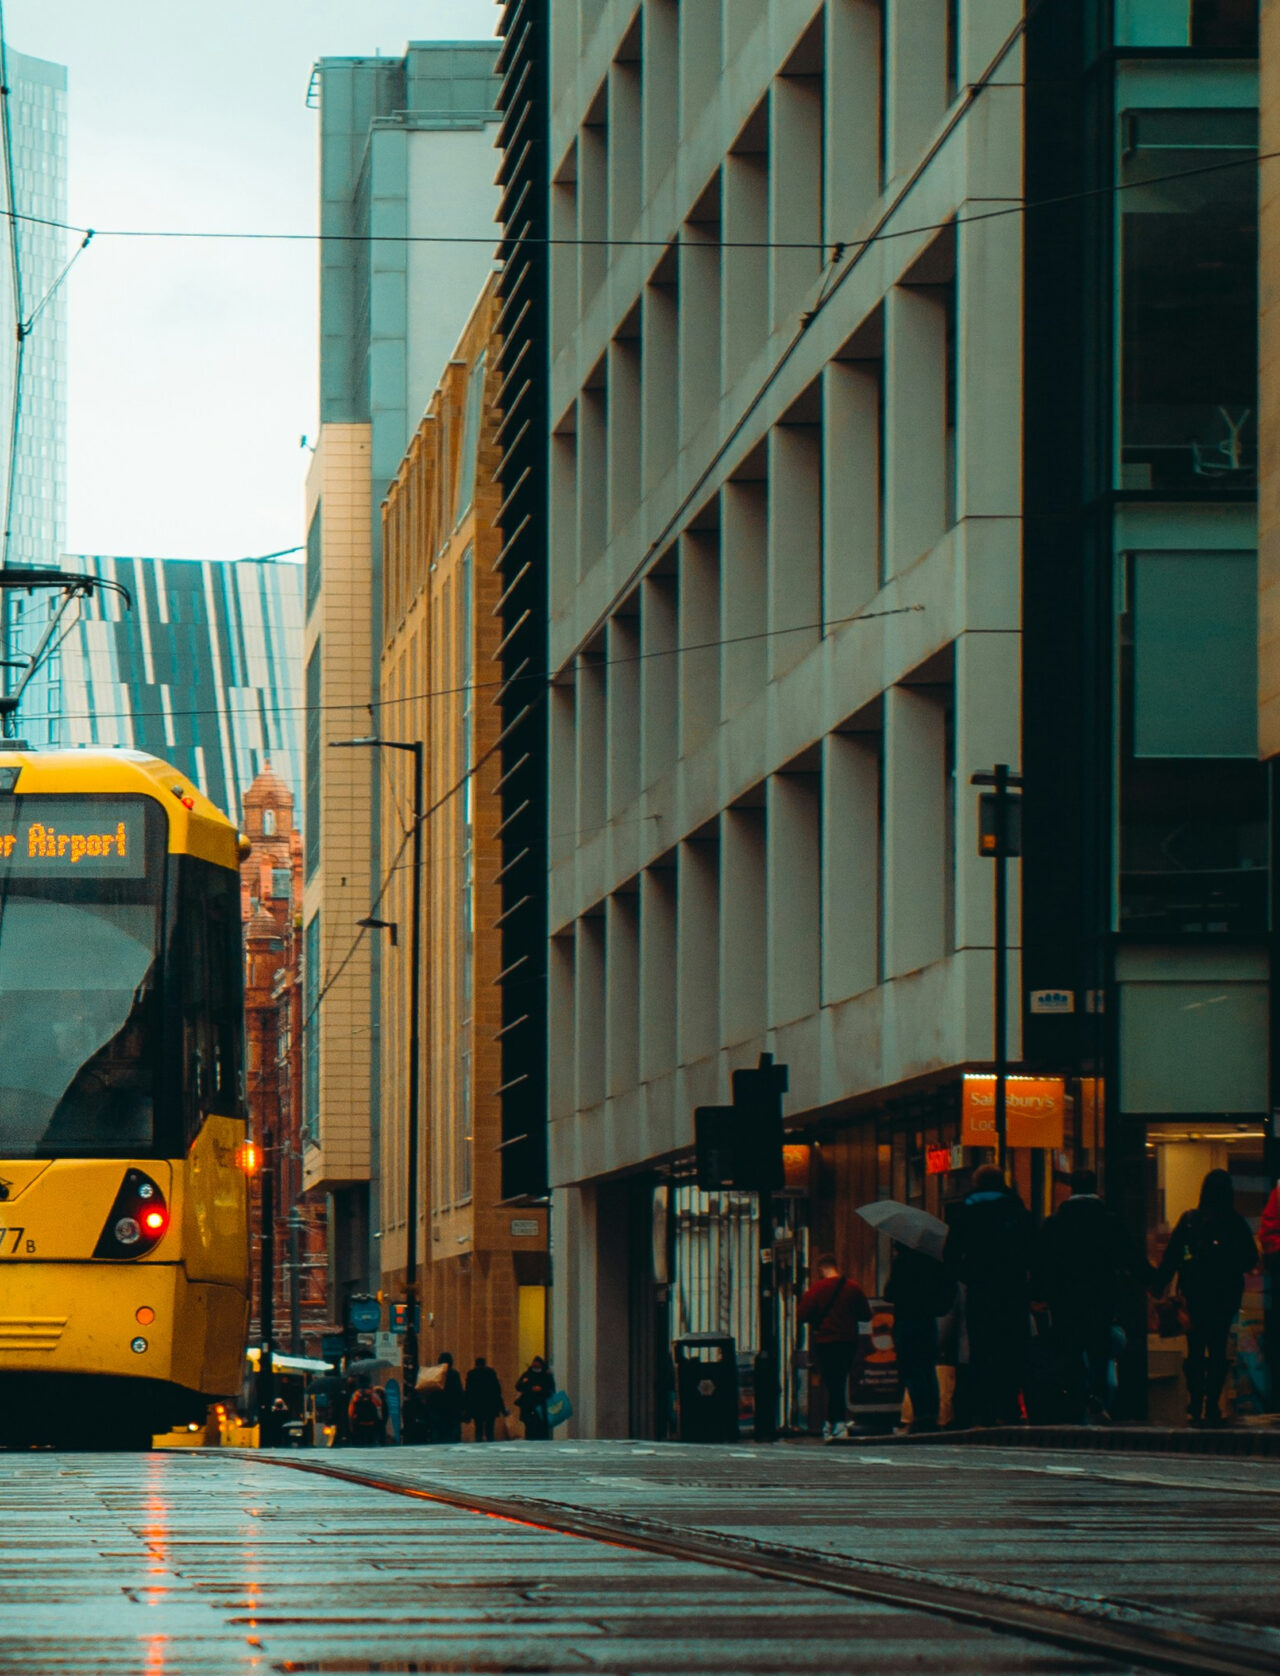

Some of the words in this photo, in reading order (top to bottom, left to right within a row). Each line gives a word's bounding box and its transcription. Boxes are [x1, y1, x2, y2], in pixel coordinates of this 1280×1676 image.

[27, 821, 126, 864] Airport
[970, 1092, 1055, 1110] Saisbury's
[970, 1117, 1009, 1131] Locl
